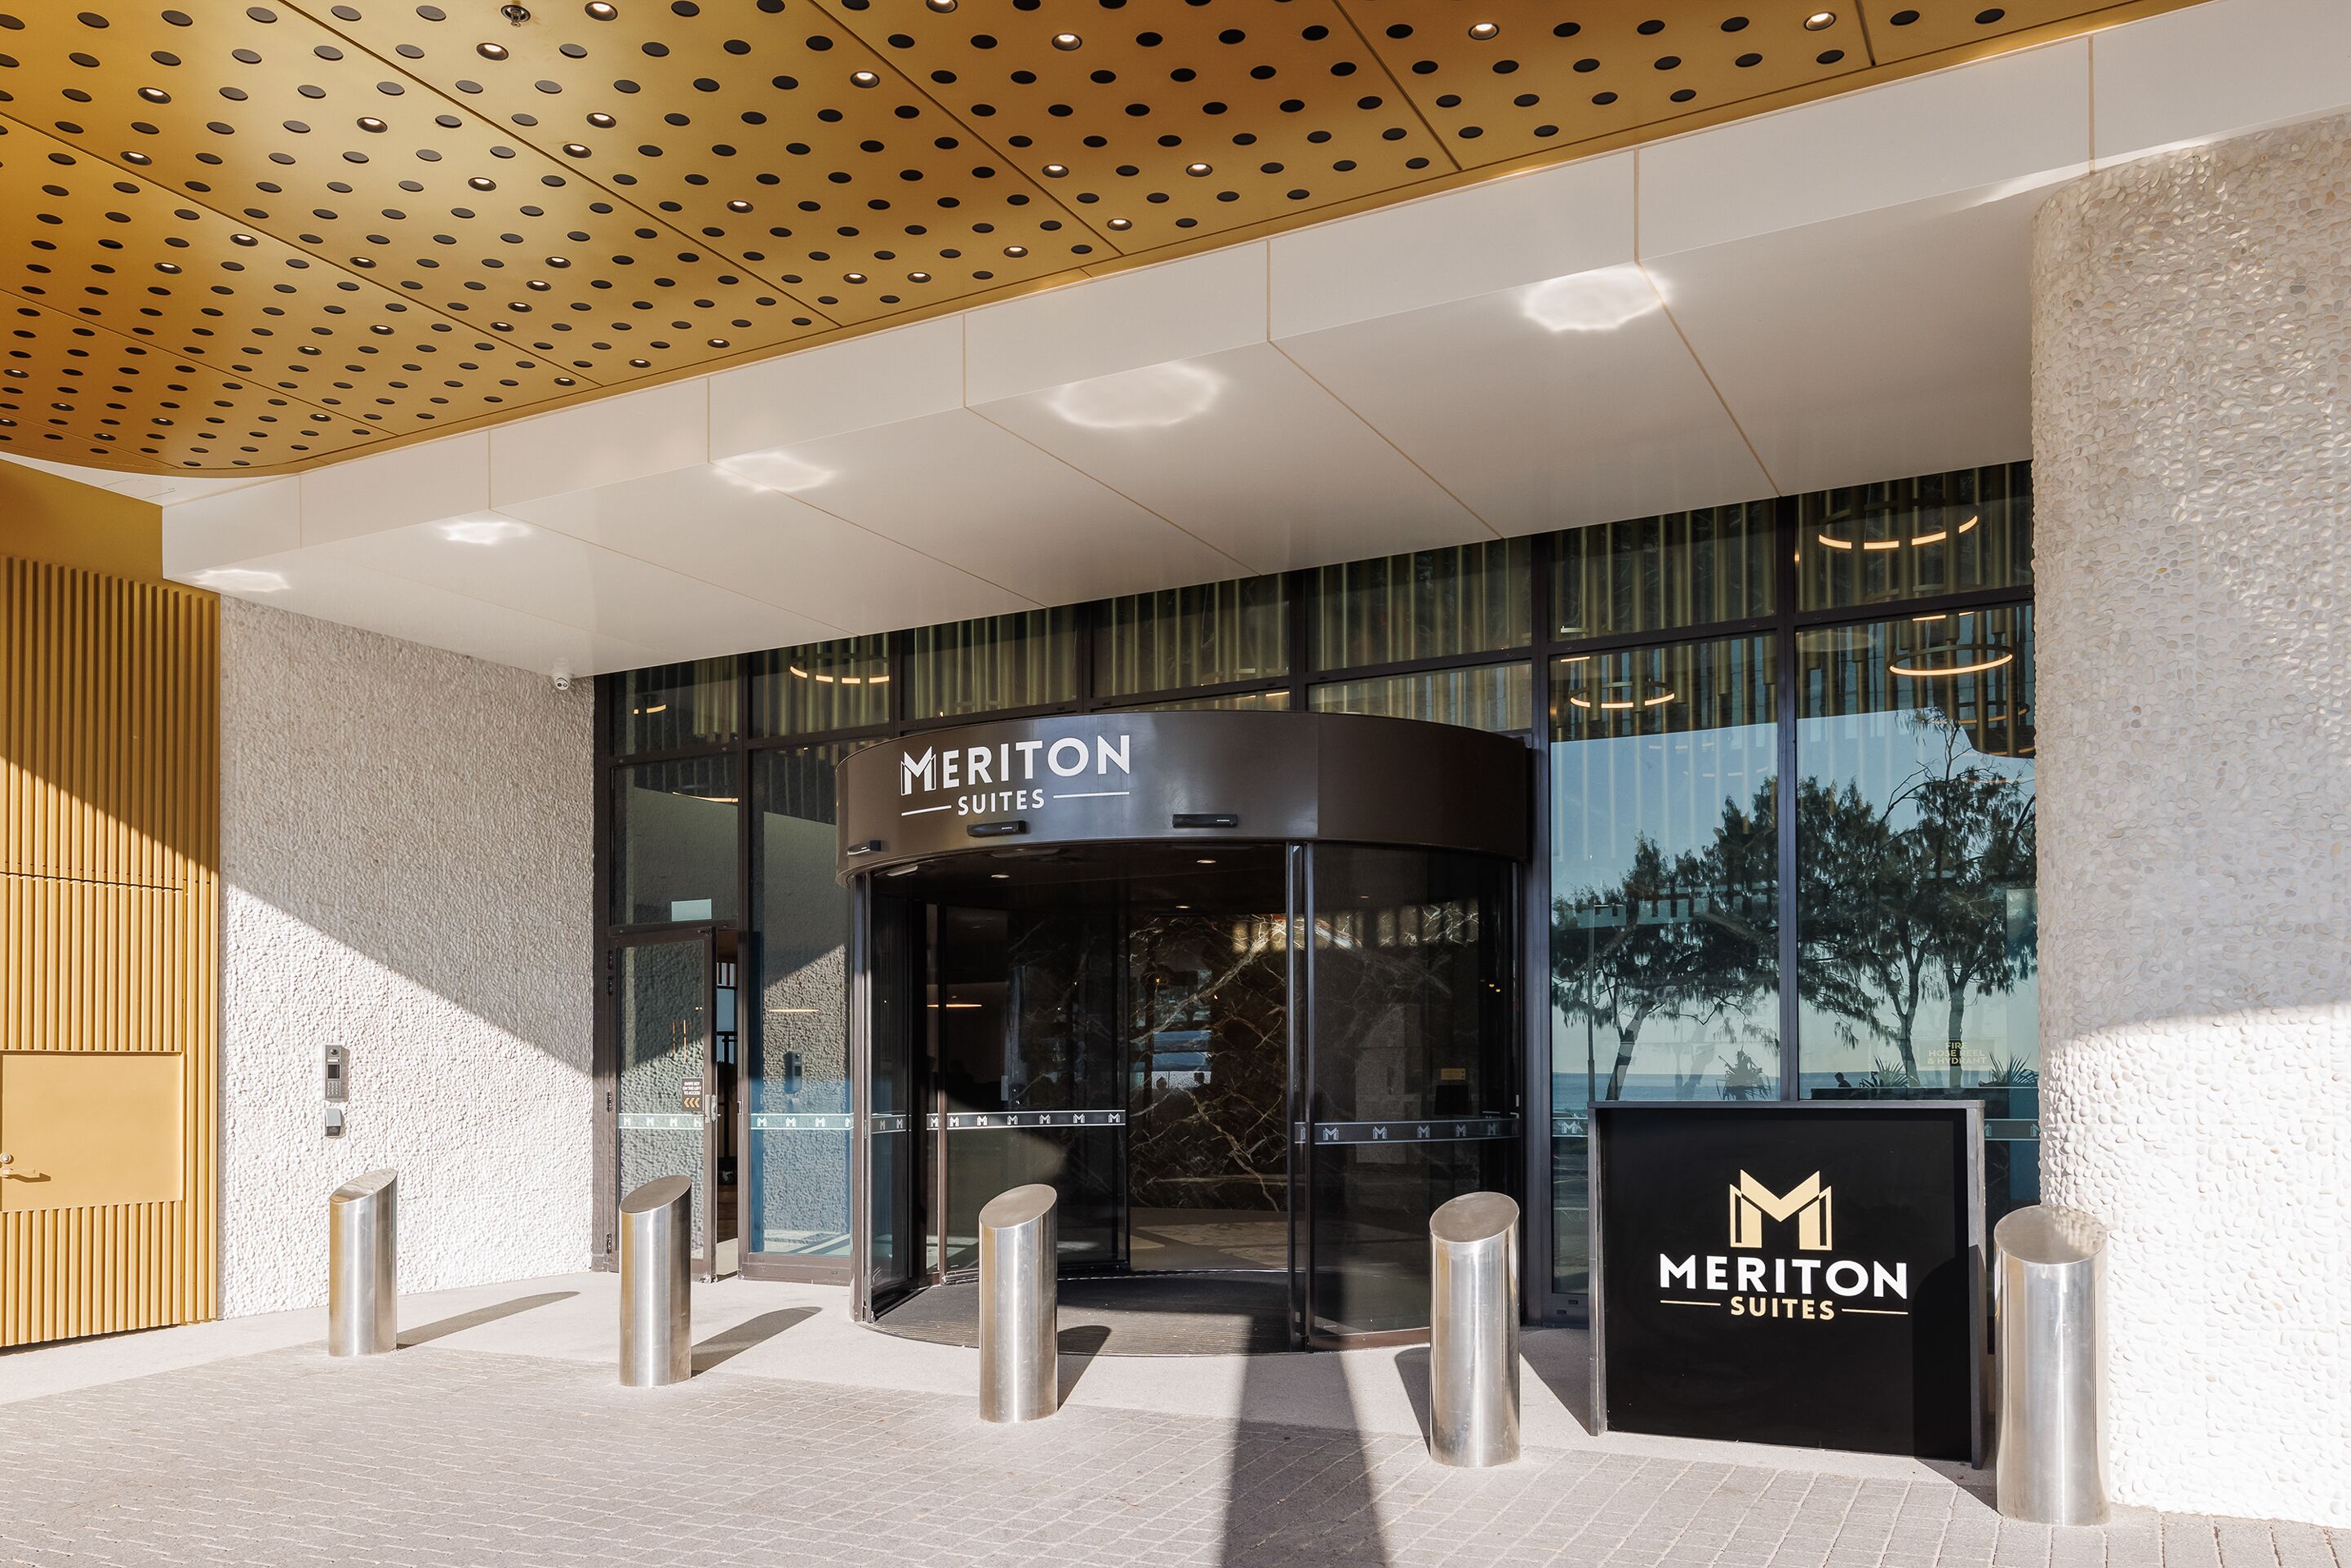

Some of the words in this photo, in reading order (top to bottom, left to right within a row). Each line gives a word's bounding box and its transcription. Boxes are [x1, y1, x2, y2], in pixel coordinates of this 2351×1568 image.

[900, 735, 1131, 796] MERITON
[958, 788, 1045, 816] SUITES
[1928, 1049, 1957, 1057] HOSE
[1959, 1049, 1985, 1057] REEL
[1729, 1169, 1833, 1251] M
[1660, 1253, 1908, 1299] MERITON
[1731, 1296, 1835, 1321] SUITES
